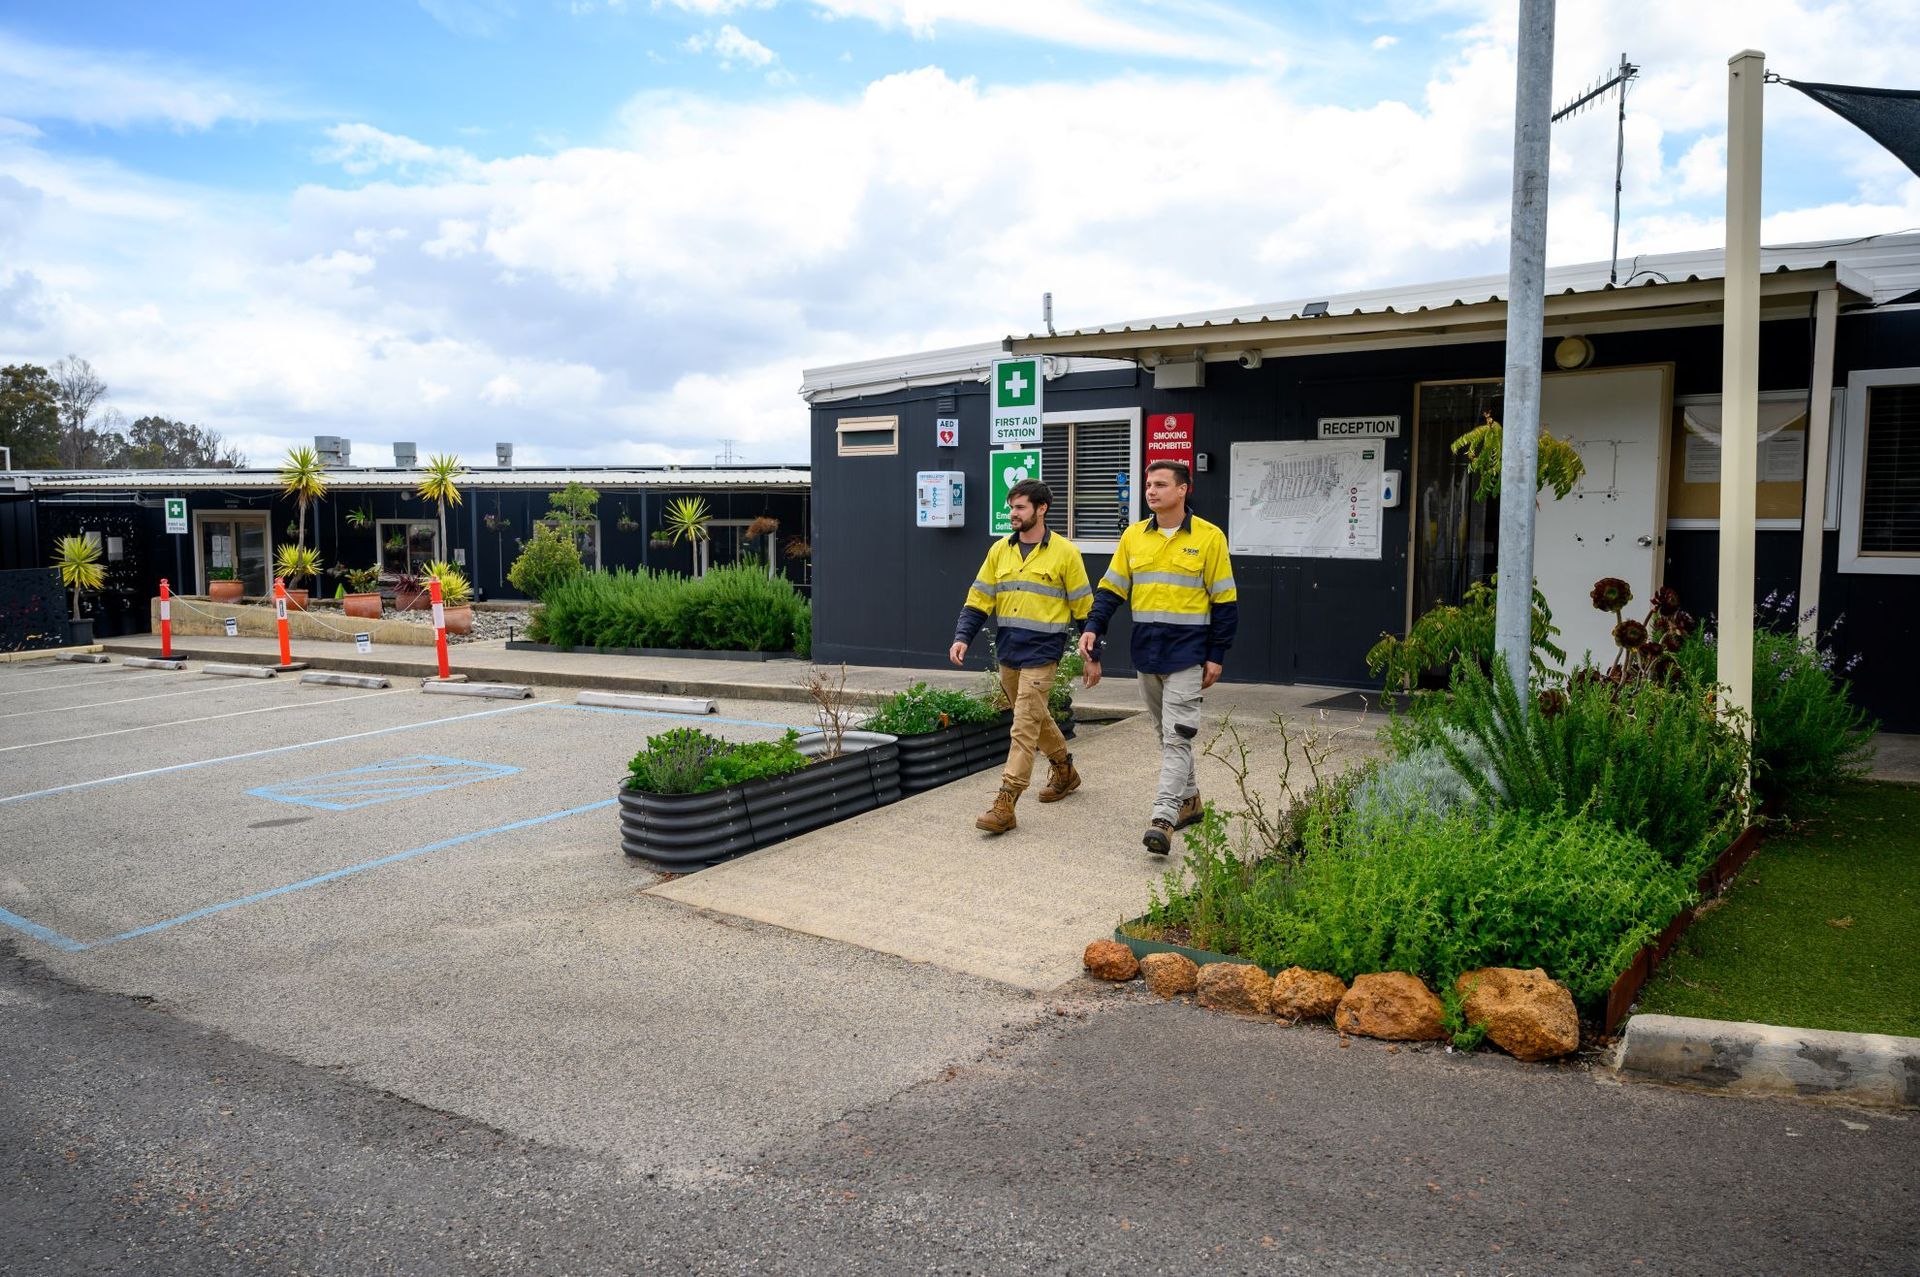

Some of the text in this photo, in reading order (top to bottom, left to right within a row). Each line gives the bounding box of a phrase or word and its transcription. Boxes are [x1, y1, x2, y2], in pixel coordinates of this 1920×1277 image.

[995, 416, 1038, 427] FIRST AID
[997, 428, 1036, 438] STATION
[1323, 421, 1395, 435] RECEPTION
[1153, 431, 1187, 440] SMOKING
[1148, 441, 1192, 450] PROHIBITED
